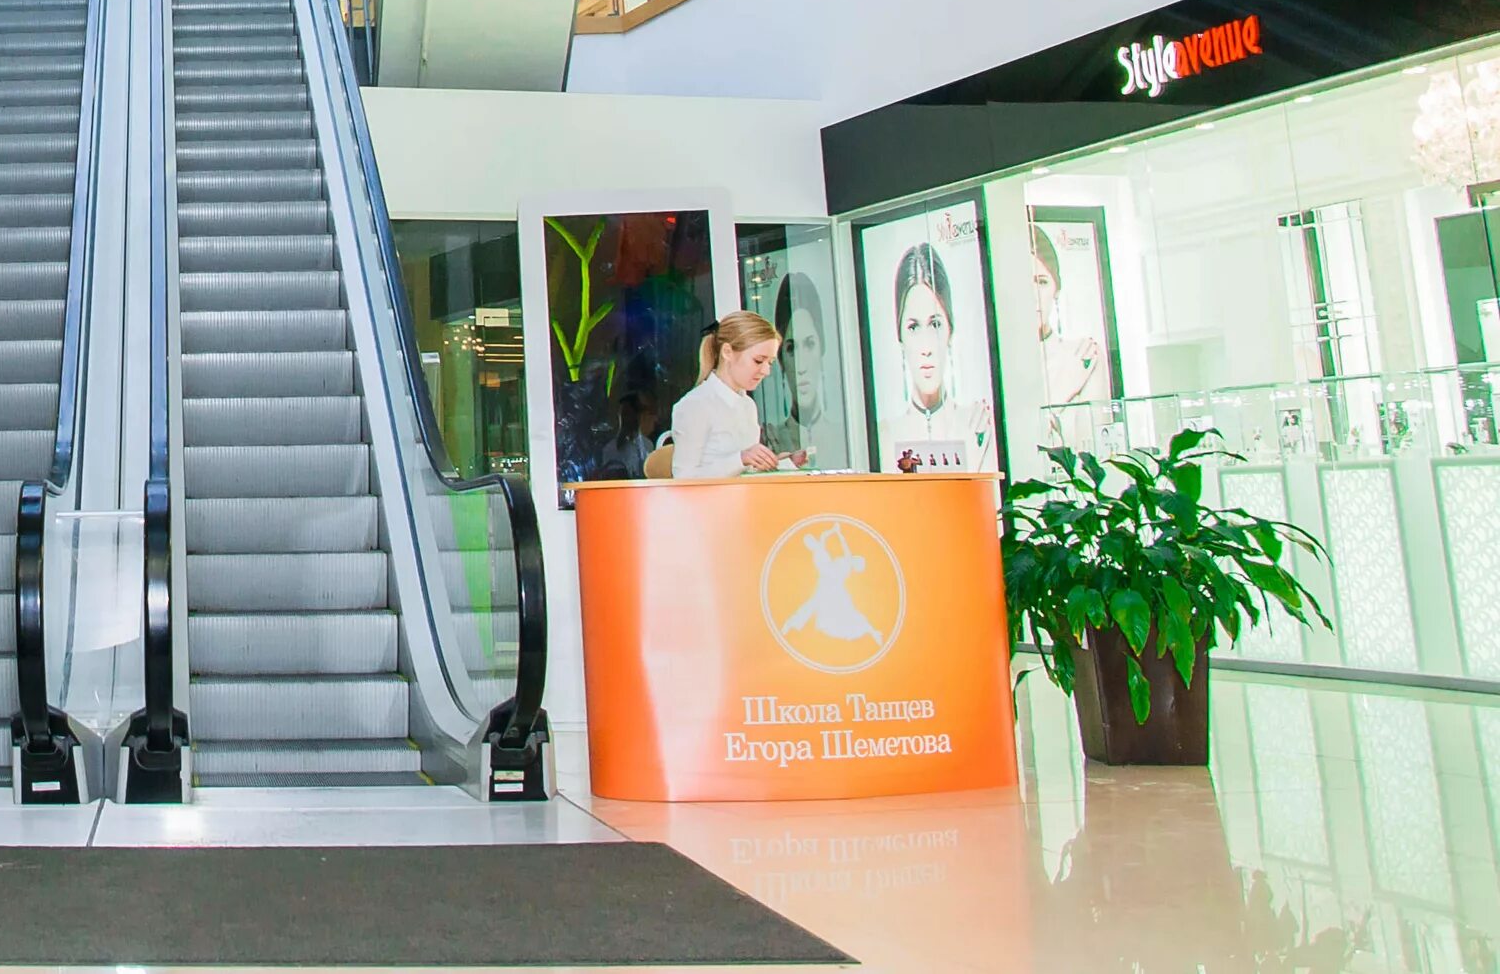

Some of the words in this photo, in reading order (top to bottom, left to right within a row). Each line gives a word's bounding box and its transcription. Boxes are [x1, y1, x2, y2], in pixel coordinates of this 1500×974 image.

[741, 696, 843, 725] Школа
[846, 693, 936, 723] Танцев
[723, 732, 815, 768] Егора
[819, 729, 953, 760] Шеметова
